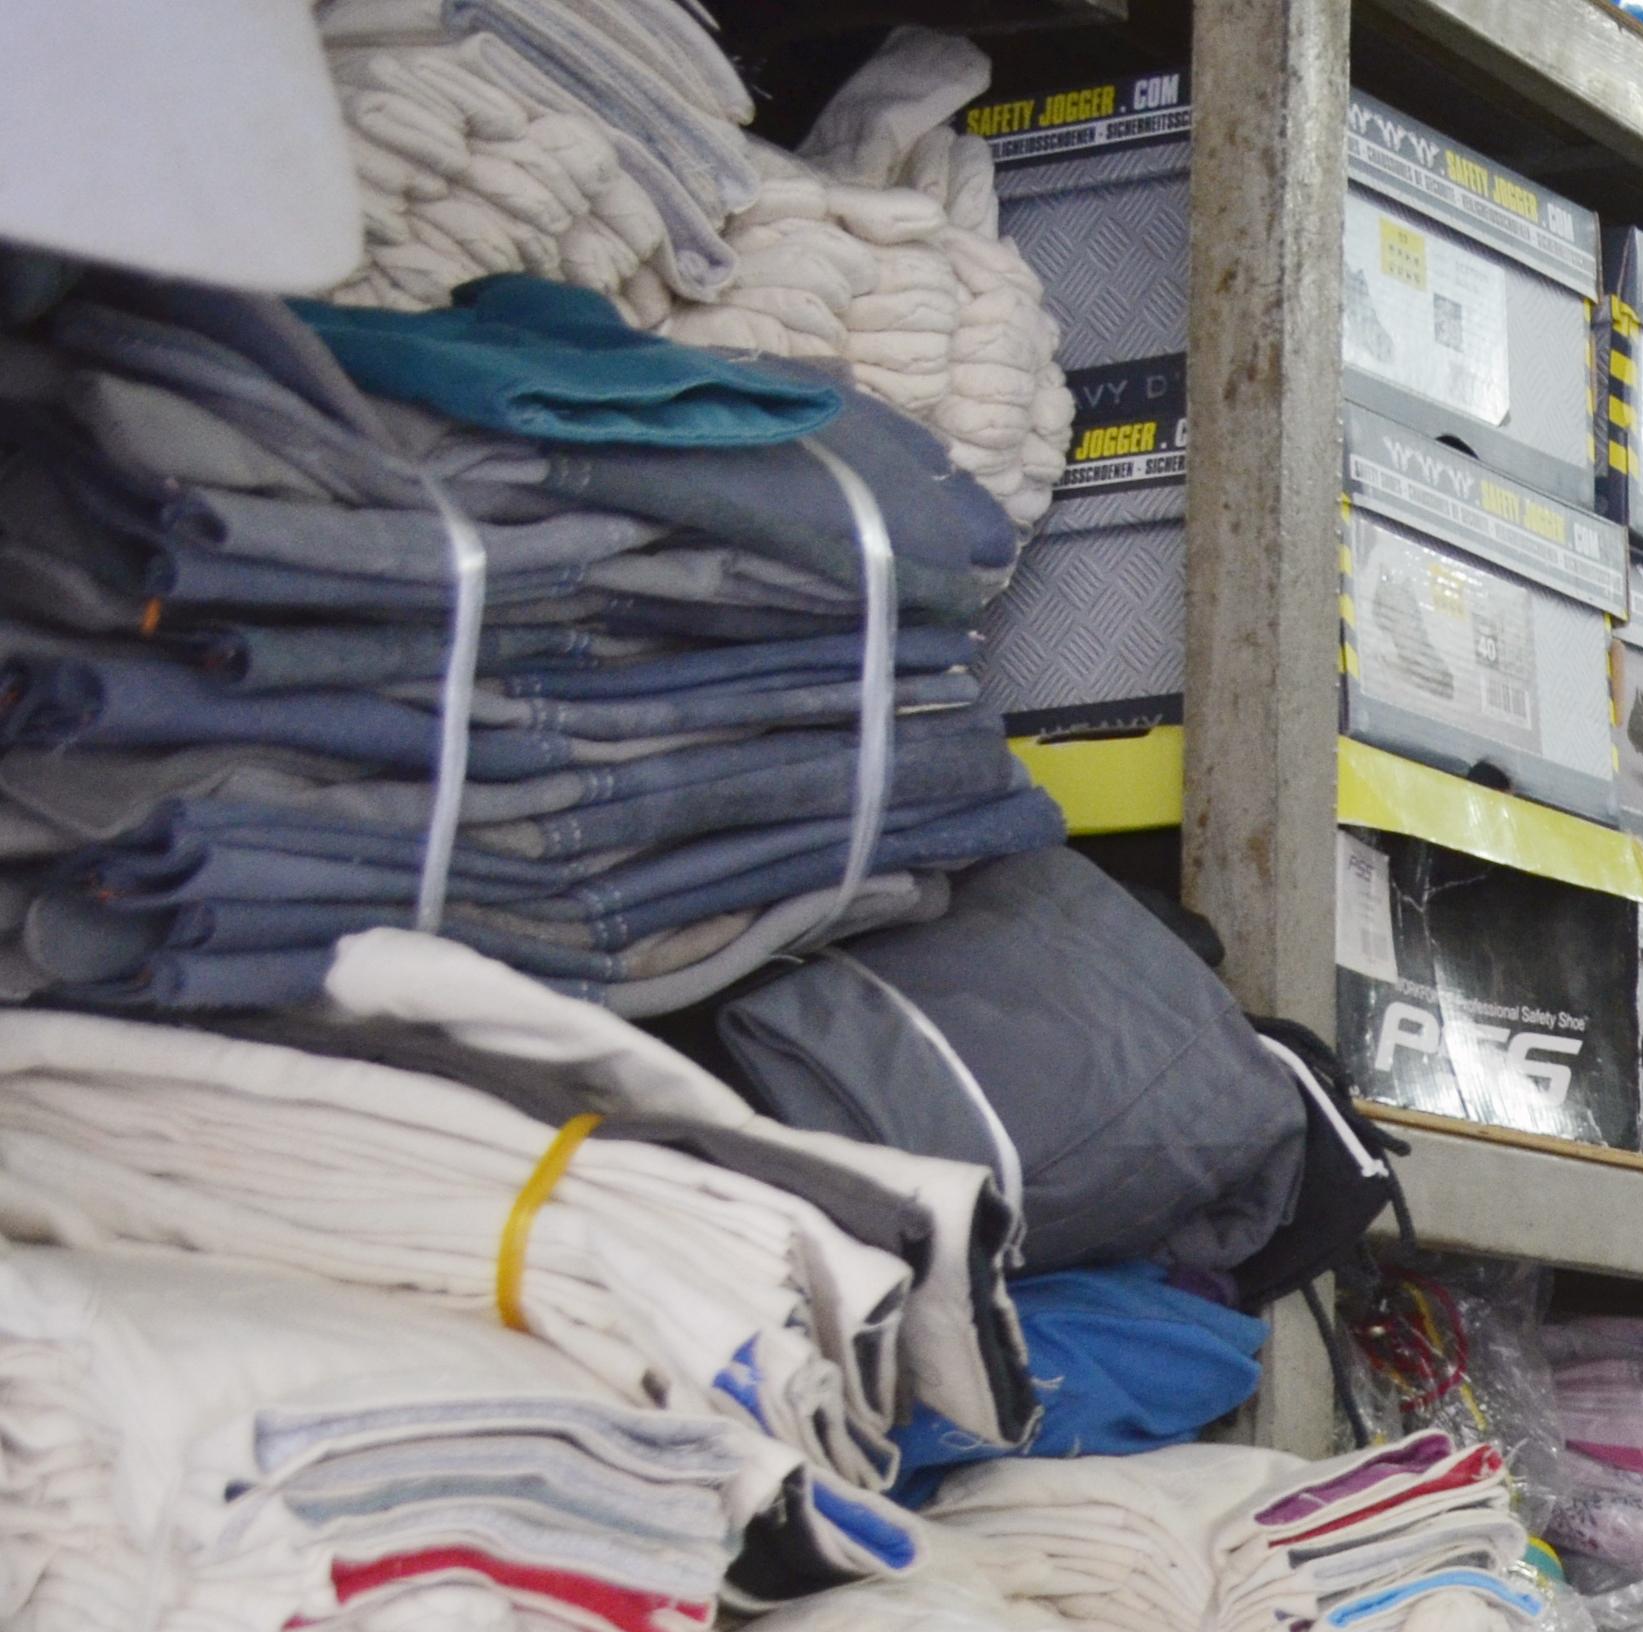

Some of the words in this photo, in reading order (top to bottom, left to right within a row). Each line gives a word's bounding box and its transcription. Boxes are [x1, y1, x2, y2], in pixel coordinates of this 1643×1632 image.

[967, 99, 1034, 137] SAFETY
[1039, 85, 1116, 127] JOGGER
[1075, 421, 1157, 460] JOGGER
[1478, 635, 1497, 661] 40
[1521, 1005, 1556, 1029] Safety
